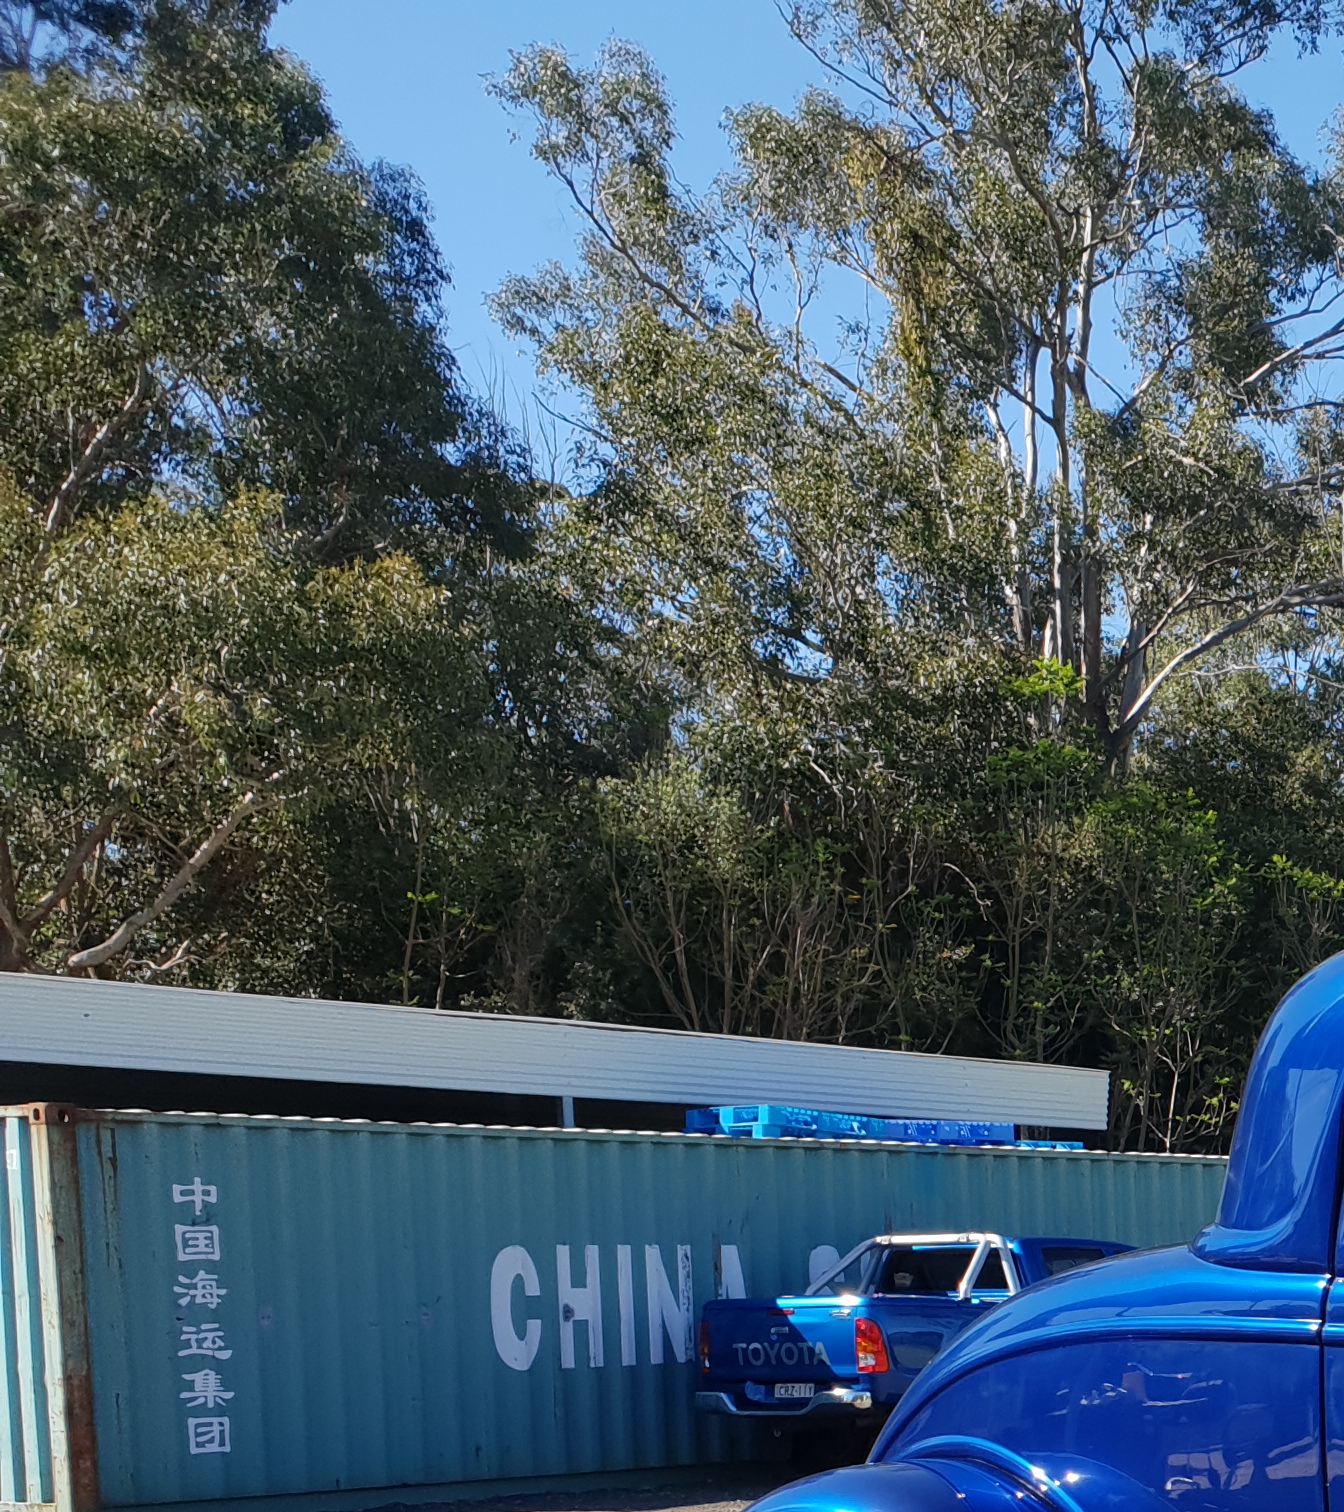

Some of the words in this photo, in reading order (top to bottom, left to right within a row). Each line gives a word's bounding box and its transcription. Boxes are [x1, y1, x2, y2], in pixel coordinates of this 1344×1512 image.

[171, 1176, 236, 1455] 中国海运集团
[732, 1341, 831, 1366] TOYOTA
